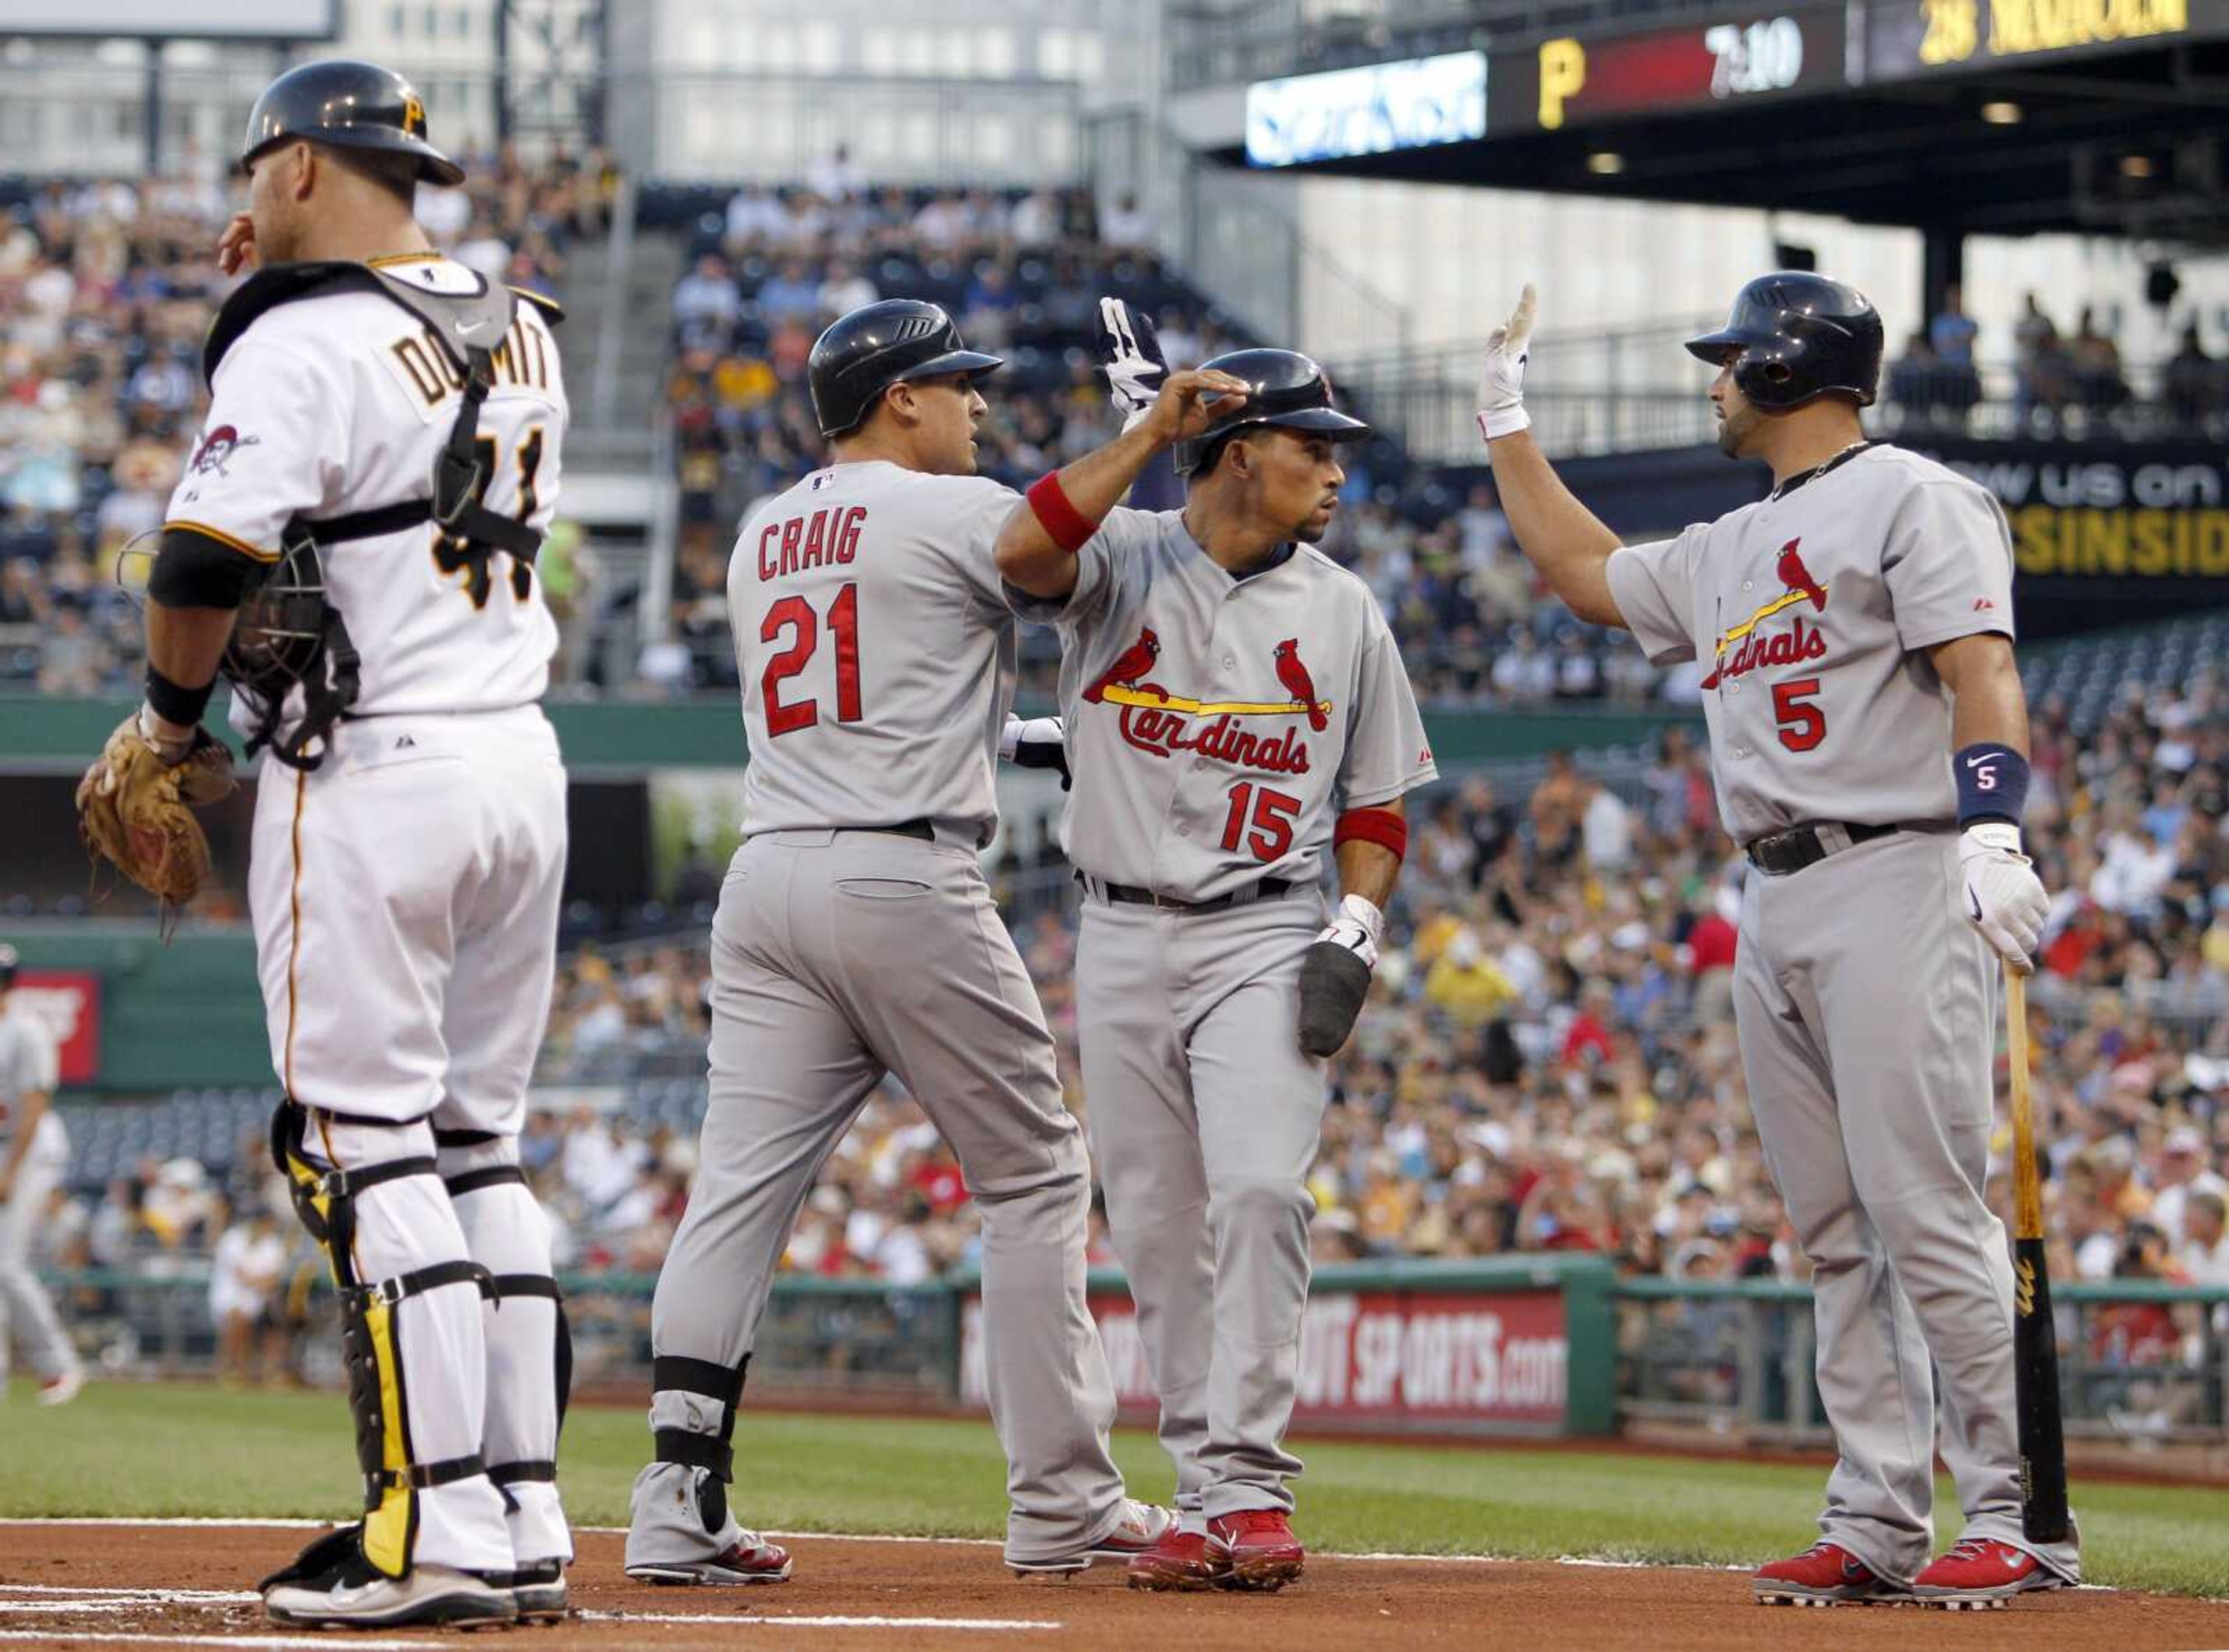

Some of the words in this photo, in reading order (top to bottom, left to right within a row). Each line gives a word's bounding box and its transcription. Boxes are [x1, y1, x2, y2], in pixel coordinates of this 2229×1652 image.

[1538, 37, 1586, 129] P
[2040, 461, 2126, 507] us
[2132, 463, 2222, 508] on
[758, 506, 868, 582] CRAIG
[2013, 504, 2229, 576] SINSID
[759, 582, 863, 739] 21
[1119, 682, 1310, 774] Cardinals
[1771, 678, 1827, 753] 5
[1976, 766, 1996, 790] 5
[1220, 781, 1303, 864] 15
